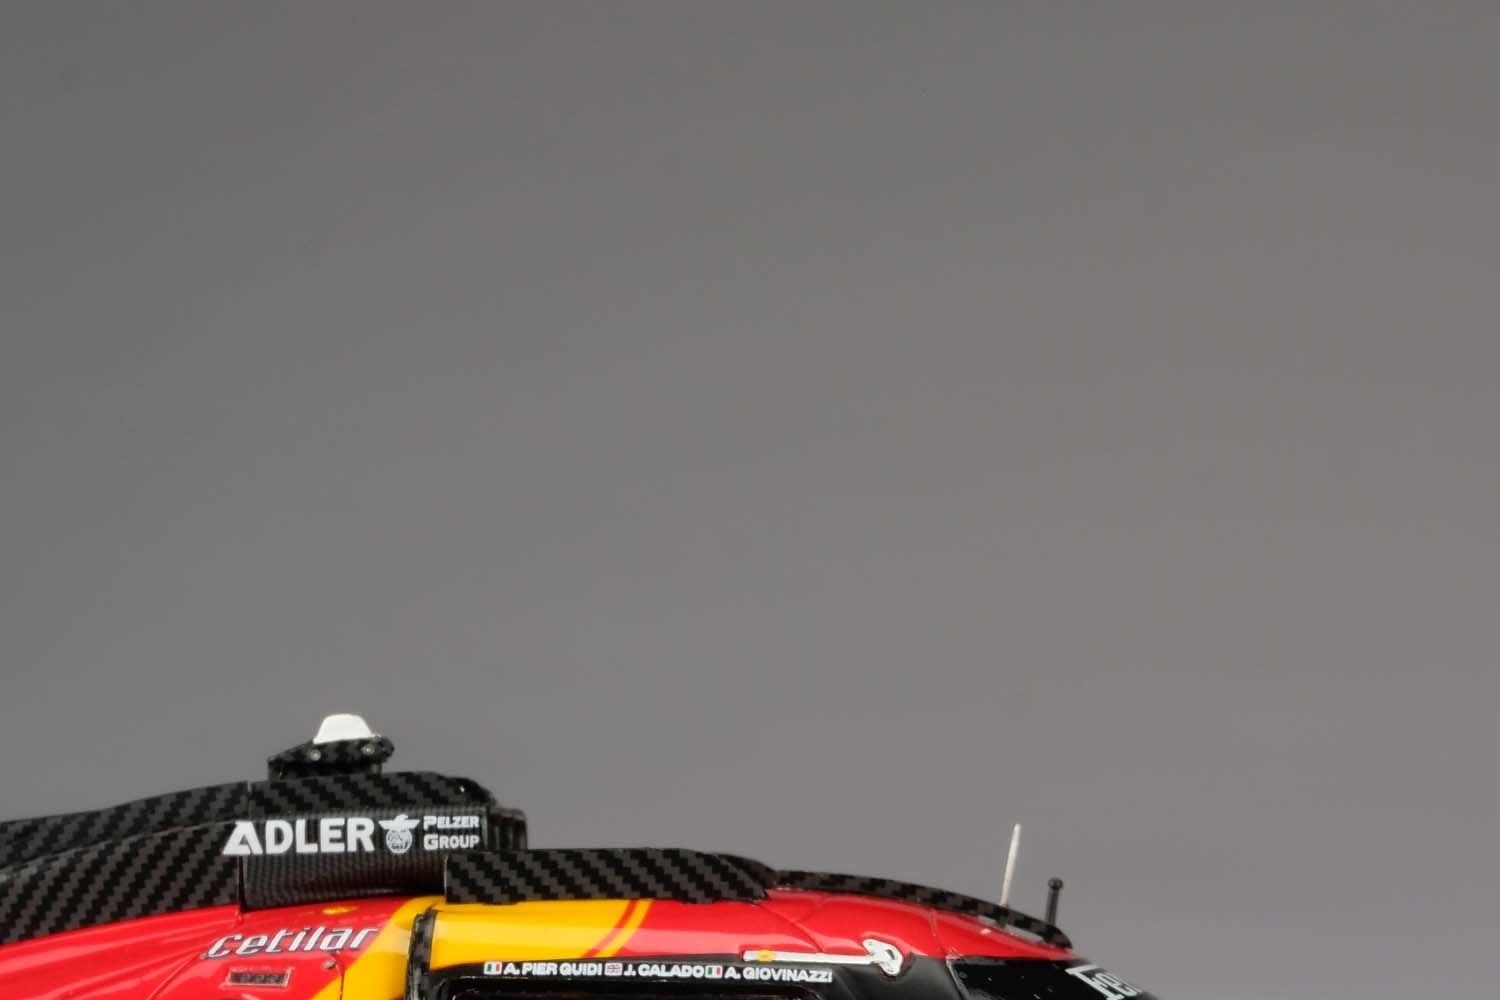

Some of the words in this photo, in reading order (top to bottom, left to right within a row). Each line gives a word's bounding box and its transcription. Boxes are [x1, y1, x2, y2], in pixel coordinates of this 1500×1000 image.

[422, 815, 480, 831] PELZER
[222, 817, 375, 855] ADLER
[423, 833, 480, 851] GROUP
[503, 963, 520, 976] A.
[521, 962, 556, 977] PIER
[558, 963, 602, 977] GUIDI
[623, 965, 636, 977] J.
[637, 964, 705, 979] CALADO
[725, 966, 741, 980] A.
[742, 966, 833, 983] GIOVINAZZI
